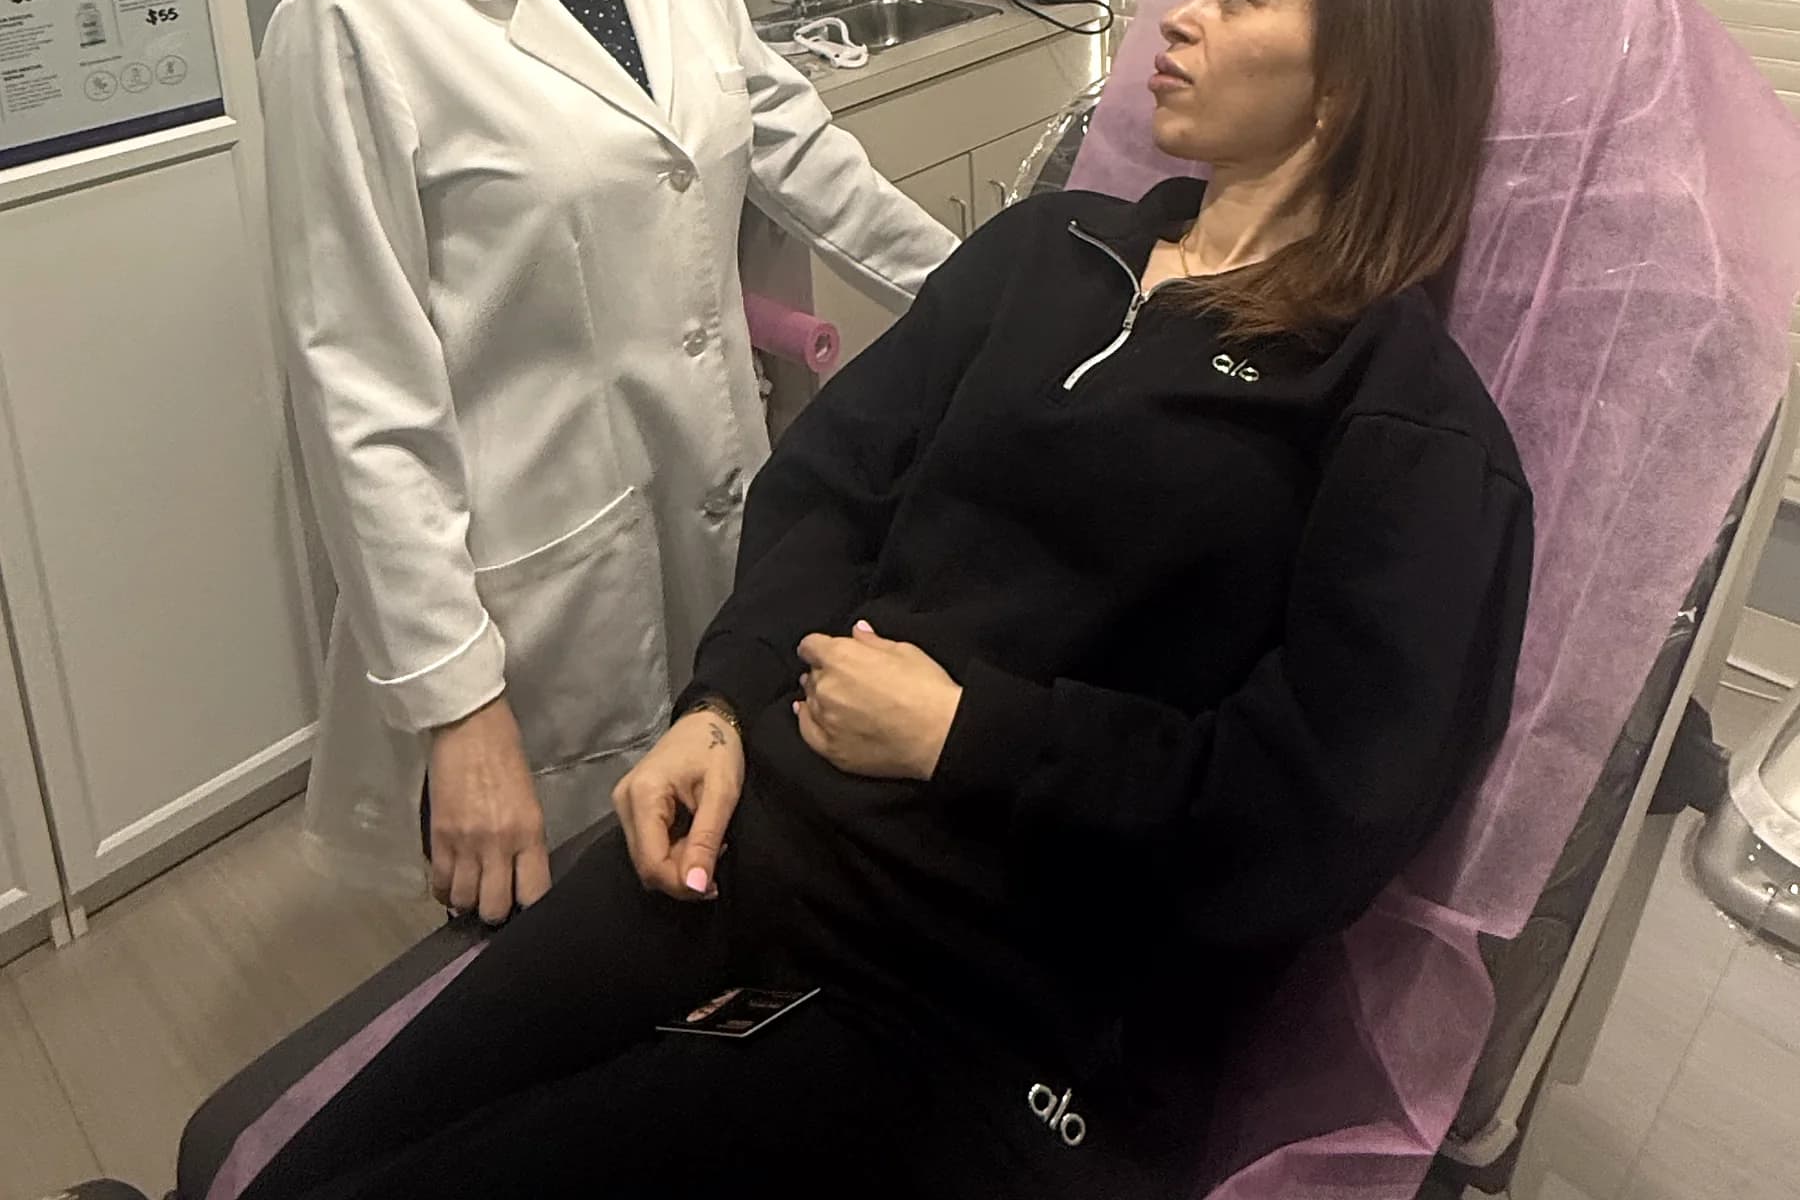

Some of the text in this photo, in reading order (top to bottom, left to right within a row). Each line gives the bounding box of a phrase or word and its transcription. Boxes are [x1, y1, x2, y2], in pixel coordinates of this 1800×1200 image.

[145, 7, 180, 26] $55
[1211, 353, 1260, 382] alo
[1027, 1082, 1087, 1147] alo
